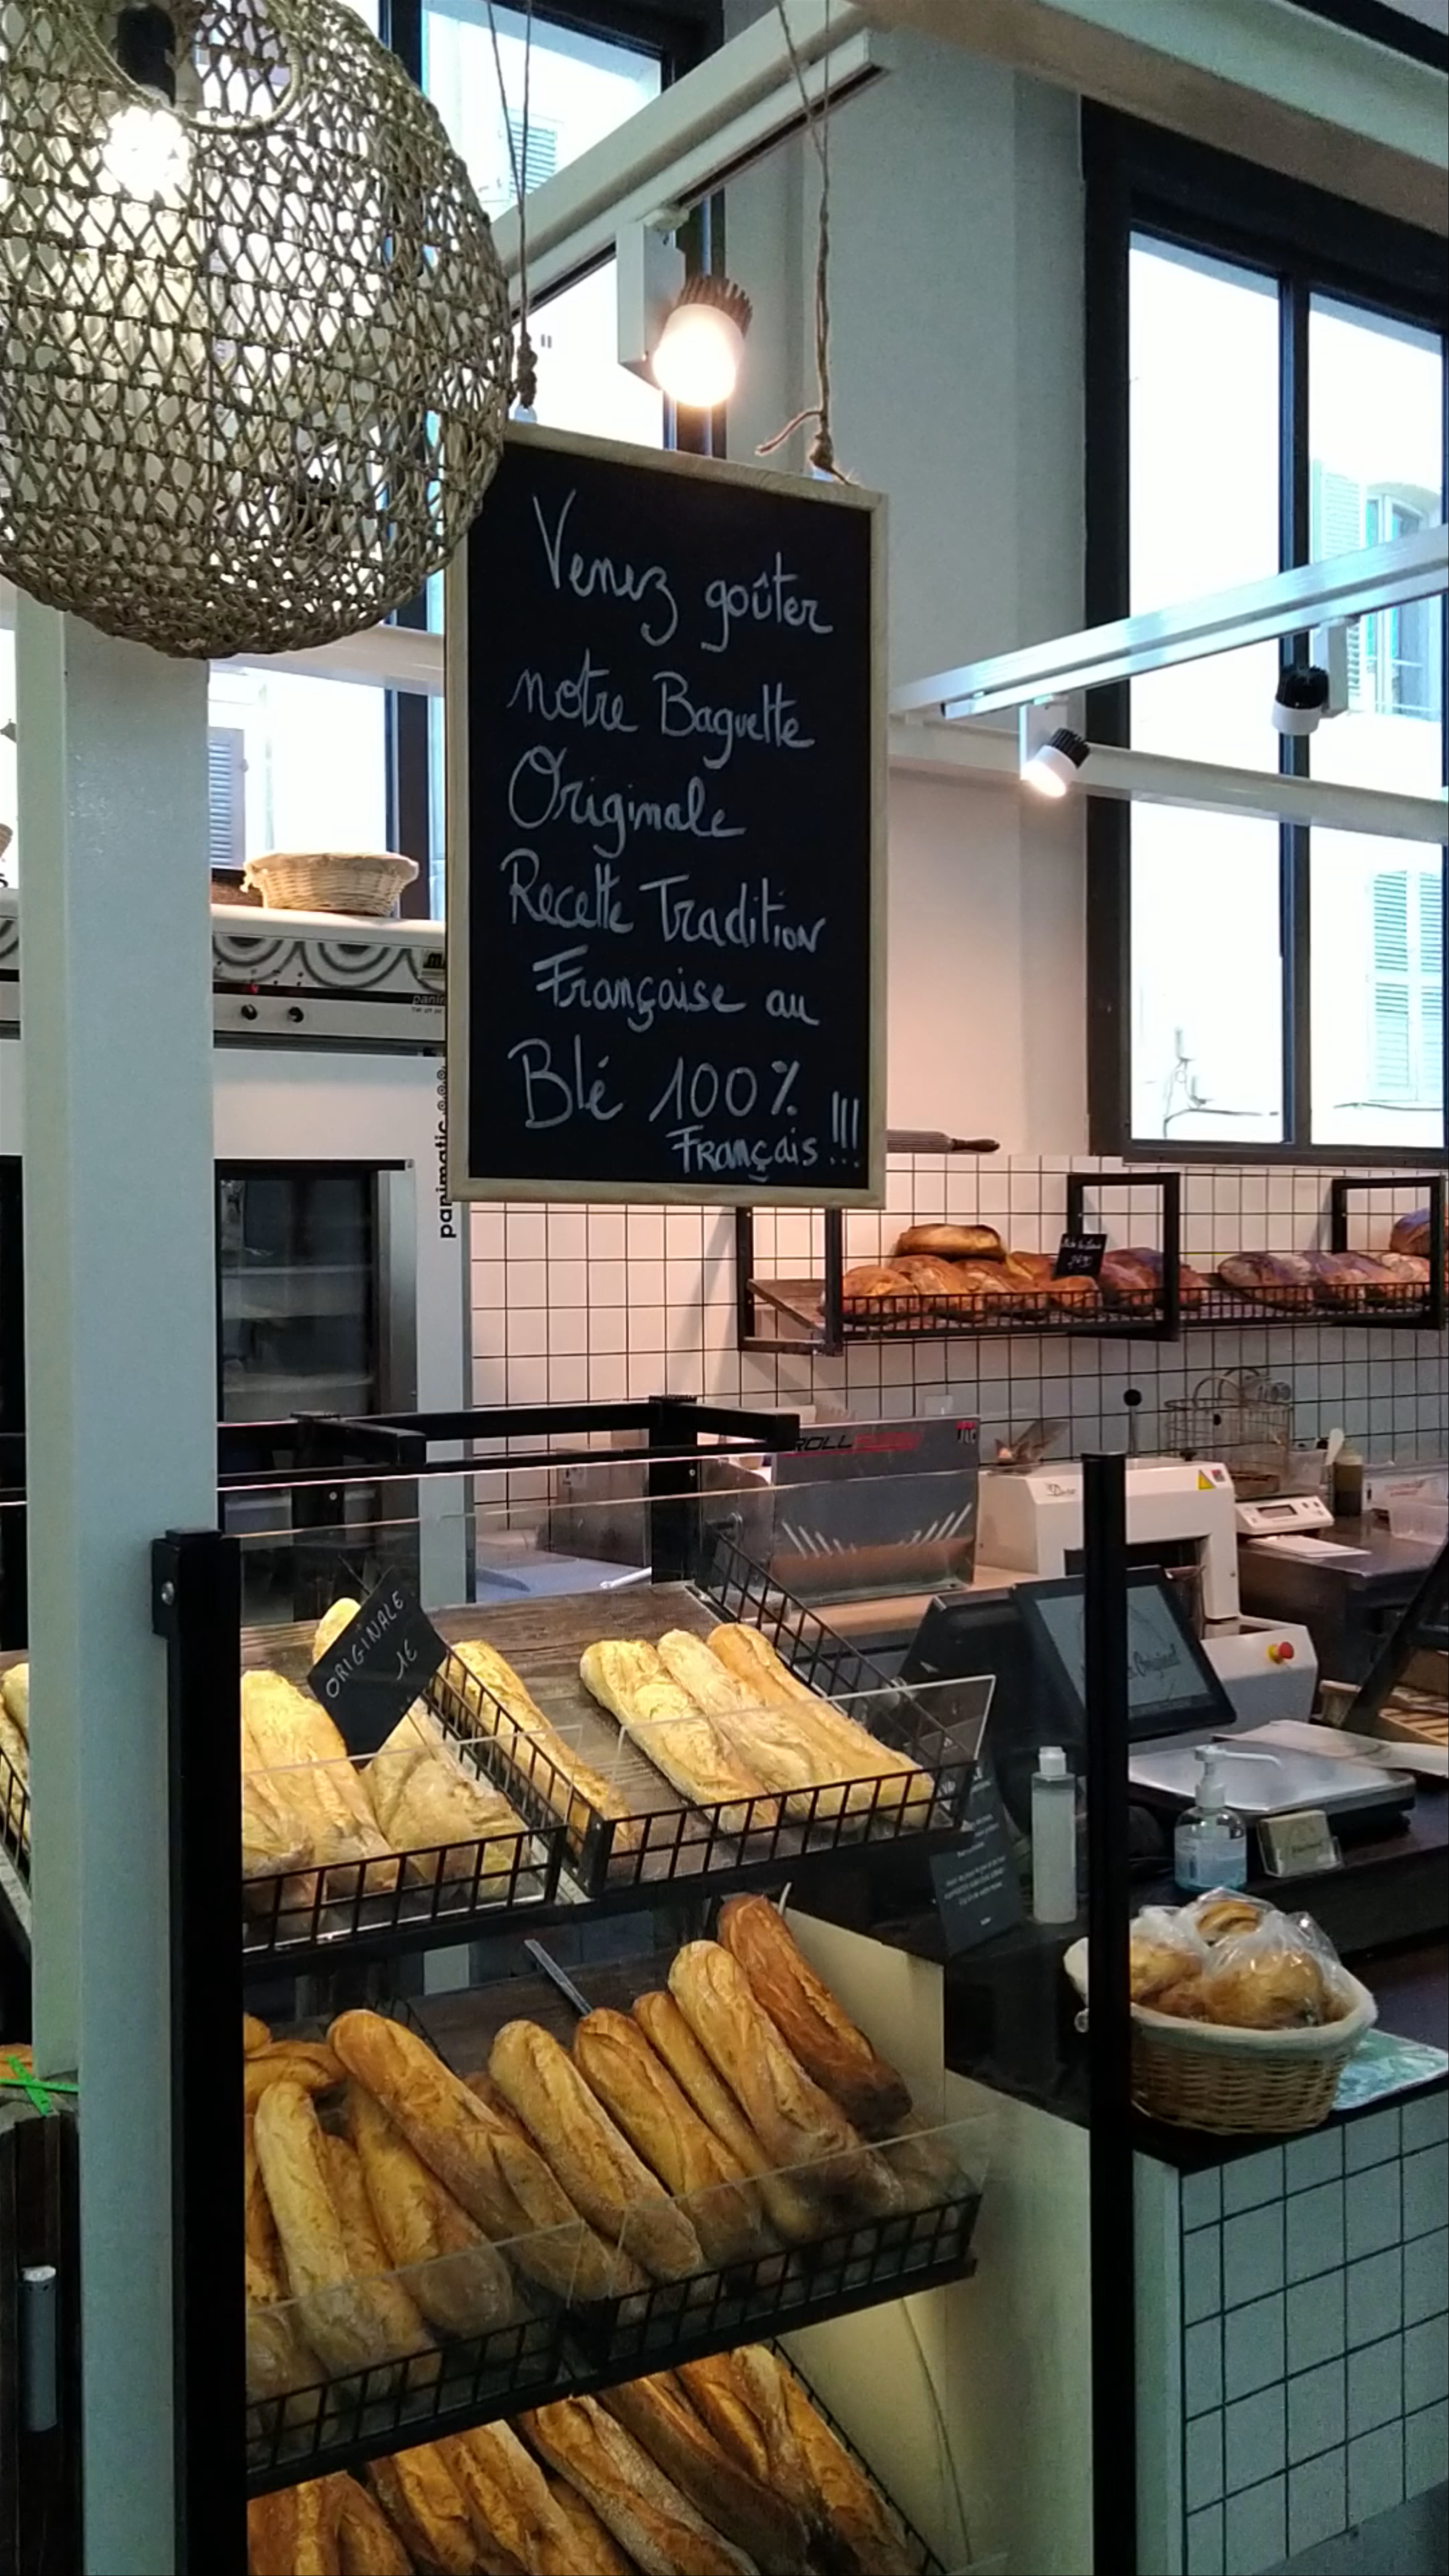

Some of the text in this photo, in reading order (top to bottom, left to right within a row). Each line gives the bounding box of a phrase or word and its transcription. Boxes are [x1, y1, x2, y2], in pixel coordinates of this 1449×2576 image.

[533, 489, 833, 652] Venez goûter
[507, 649, 815, 769] notre Baguette
[509, 745, 746, 858] Originale
[501, 848, 825, 952] Recette Tradition
[533, 945, 820, 1032] Française au
[508, 1035, 800, 1128] Blé 100%
[666, 1125, 818, 1182] Français
[326, 1590, 403, 1697] ORIGINALE
